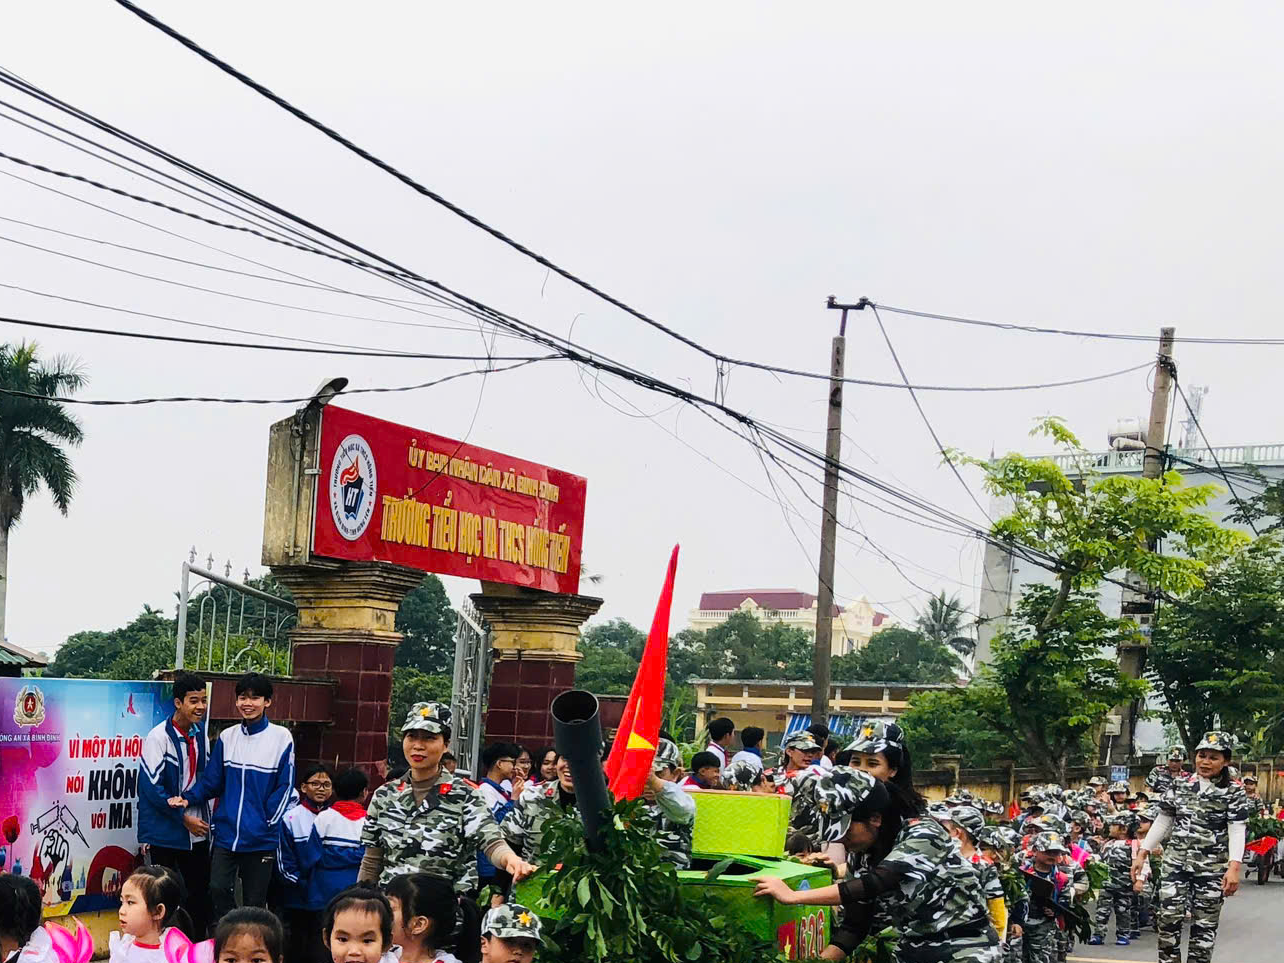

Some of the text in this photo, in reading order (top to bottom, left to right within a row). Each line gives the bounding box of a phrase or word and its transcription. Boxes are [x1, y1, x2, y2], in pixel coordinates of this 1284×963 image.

[407, 438, 425, 469] ỦY
[426, 451, 449, 475] BAN
[449, 456, 478, 483] NHÂN
[479, 462, 501, 488] DÂN
[501, 468, 517, 491] XÃ
[345, 486, 359, 508] HT
[380, 488, 571, 574] TRƯỜNG TIỂU HỌC VÀ THCS HỒNG TIẾN
[13, 734, 22, 742] AN
[69, 733, 143, 763] VÌ MỘT XÃ HỘI
[66, 763, 140, 801] NÓI KHÔN
[91, 807, 107, 830] VỚI
[109, 803, 133, 830] MA
